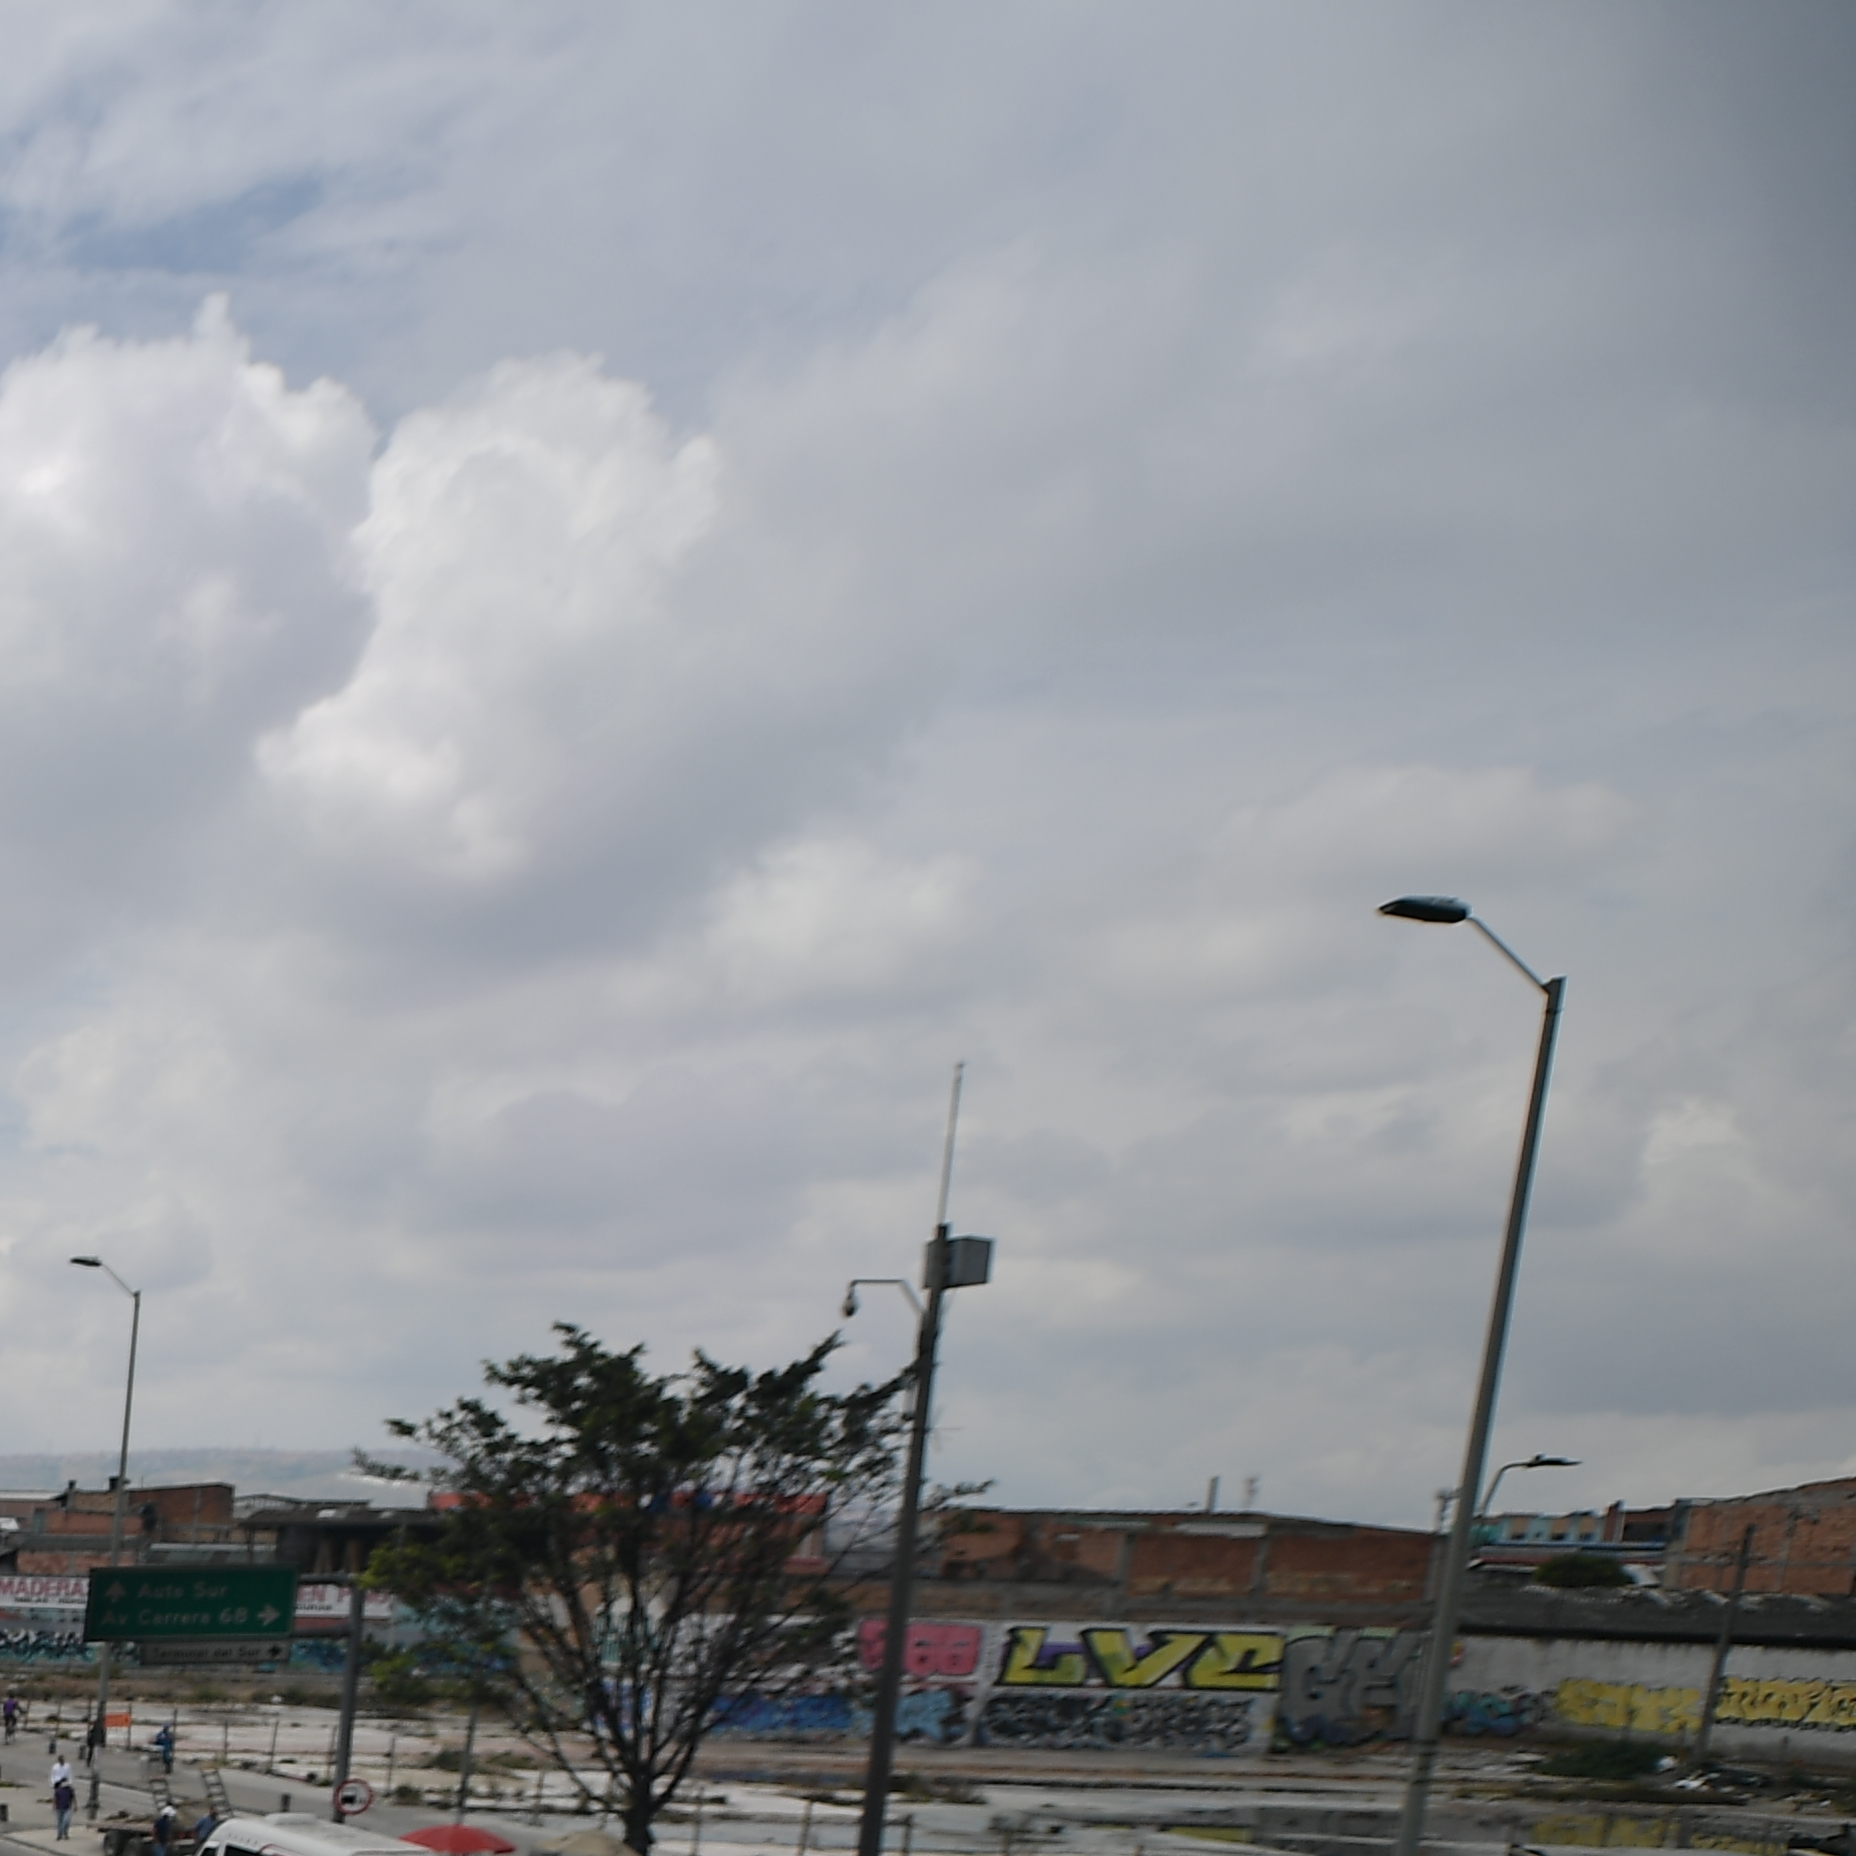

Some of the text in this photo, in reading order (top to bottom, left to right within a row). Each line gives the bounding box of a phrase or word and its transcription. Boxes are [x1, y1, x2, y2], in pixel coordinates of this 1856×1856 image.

[138, 1581, 228, 1599] Auto Sur
[101, 1610, 129, 1626] Av
[138, 1609, 211, 1626] Carrera
[237, 1644, 261, 1657] Sur
